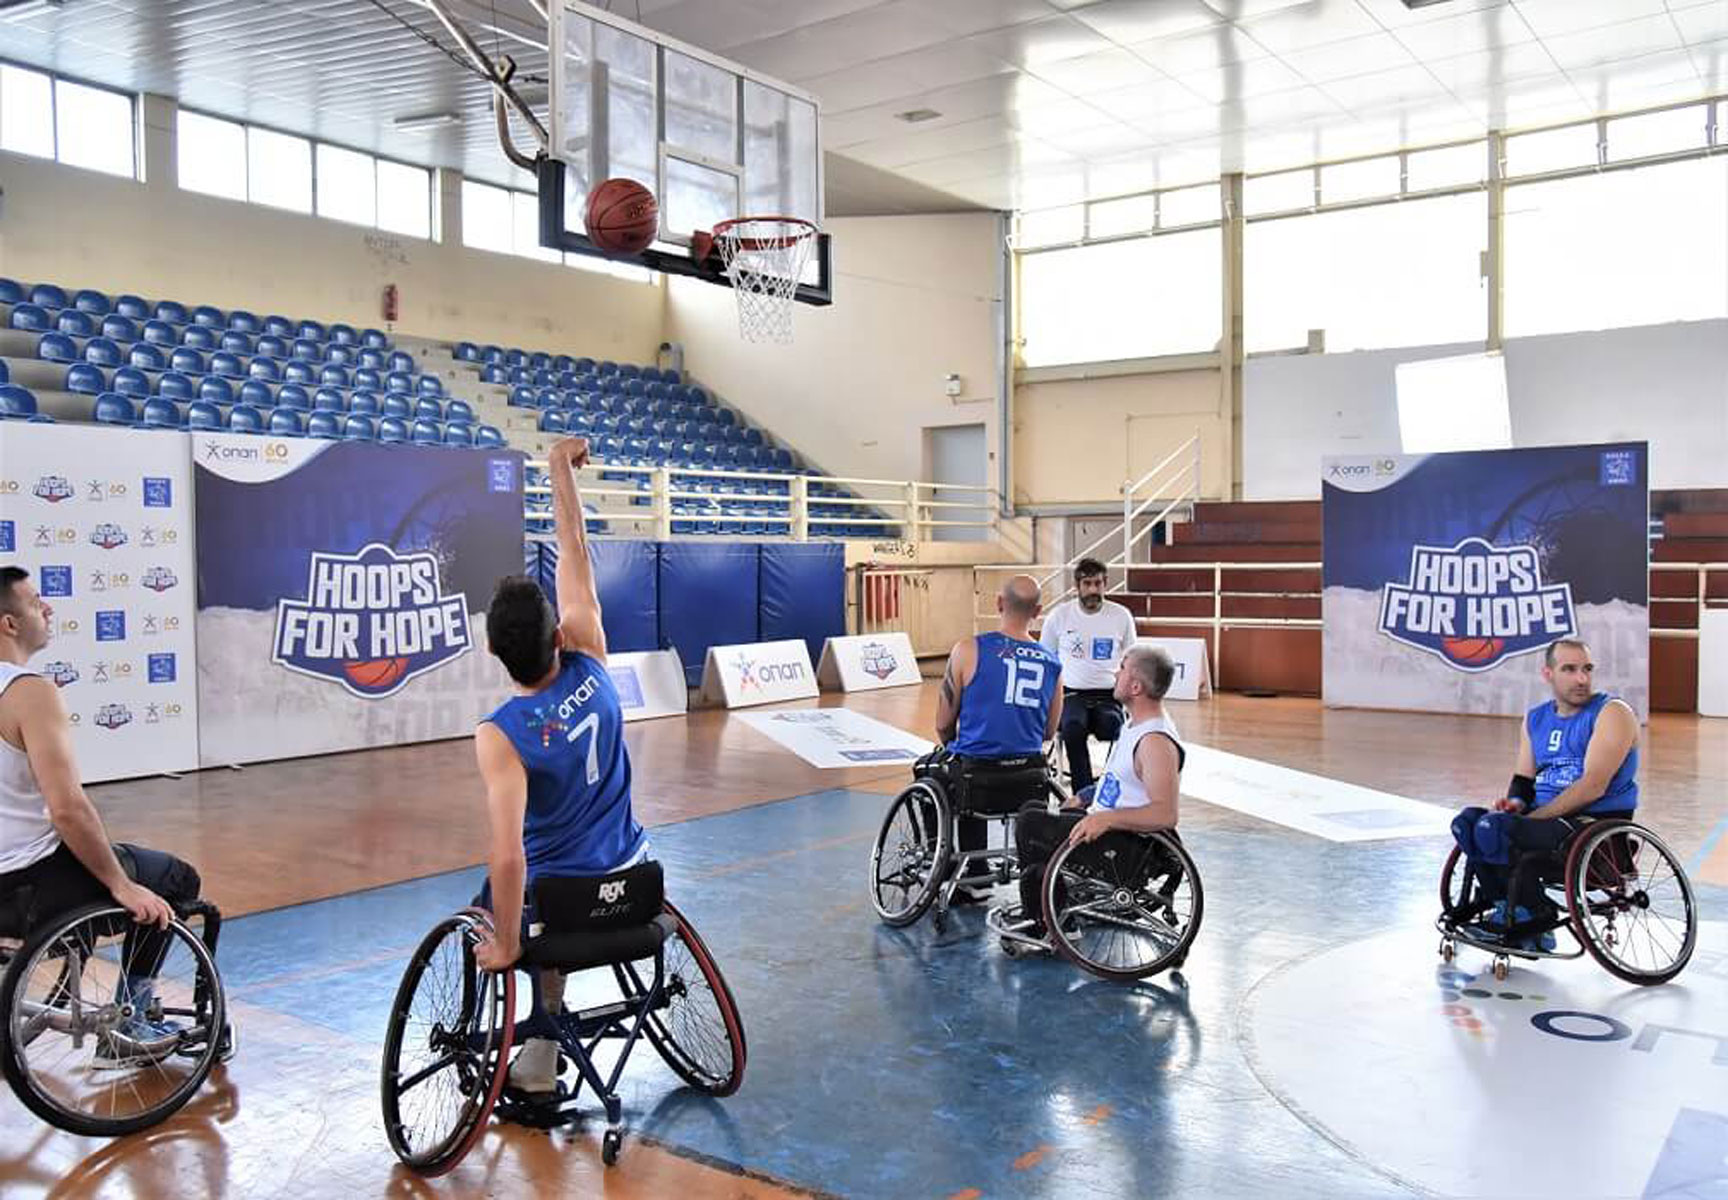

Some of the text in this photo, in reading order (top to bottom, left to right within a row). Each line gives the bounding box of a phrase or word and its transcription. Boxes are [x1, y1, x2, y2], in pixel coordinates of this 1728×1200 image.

[315, 561, 435, 609] HOOPS
[1416, 553, 1534, 595] HOOPS
[281, 602, 466, 659] FOR HOPE
[1386, 591, 1570, 637] FOR HOPE
[1003, 658, 1044, 708] 12
[566, 712, 600, 786] 7
[1547, 729, 1562, 751] 9
